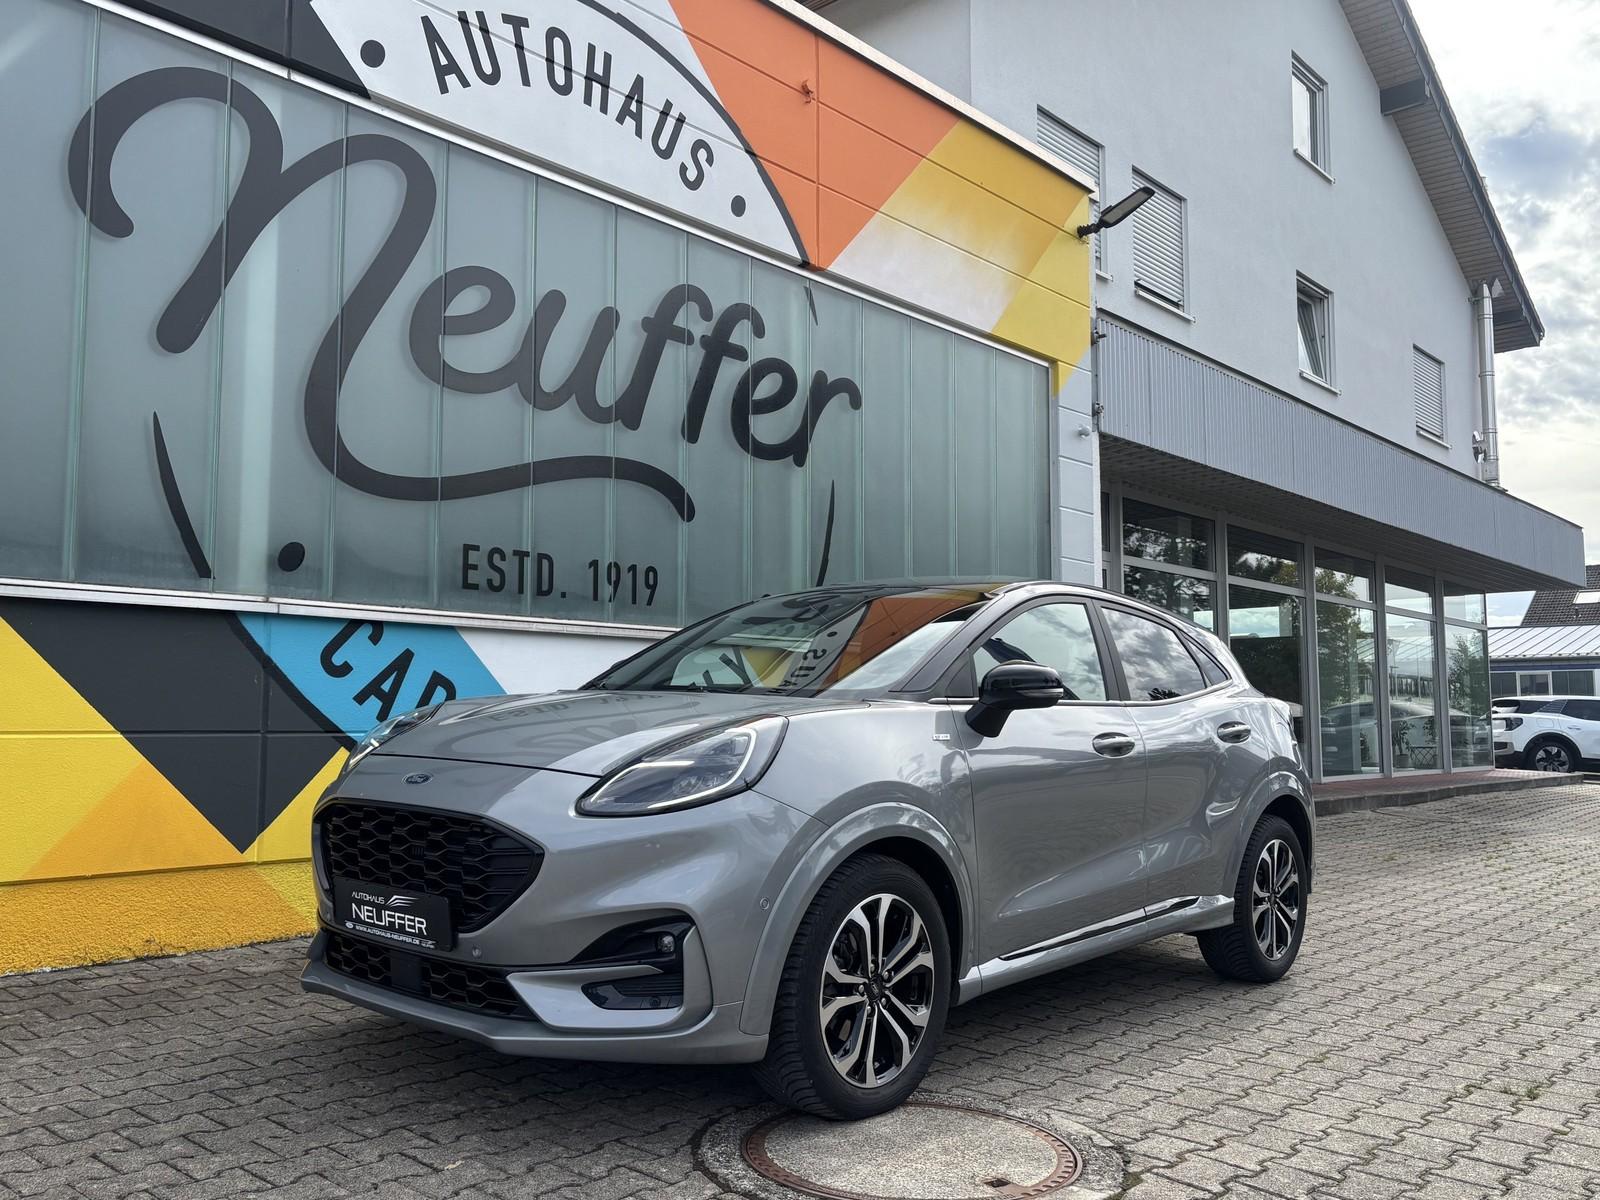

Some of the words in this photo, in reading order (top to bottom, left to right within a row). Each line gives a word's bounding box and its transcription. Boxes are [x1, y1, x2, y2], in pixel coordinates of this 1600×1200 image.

[421, 10, 715, 192] AUTOHAUS
[461, 543, 567, 599] ESTD.
[588, 559, 659, 606] 1919
[351, 891, 385, 905] AUTOHAUS
[352, 903, 428, 936] NEUFFER
